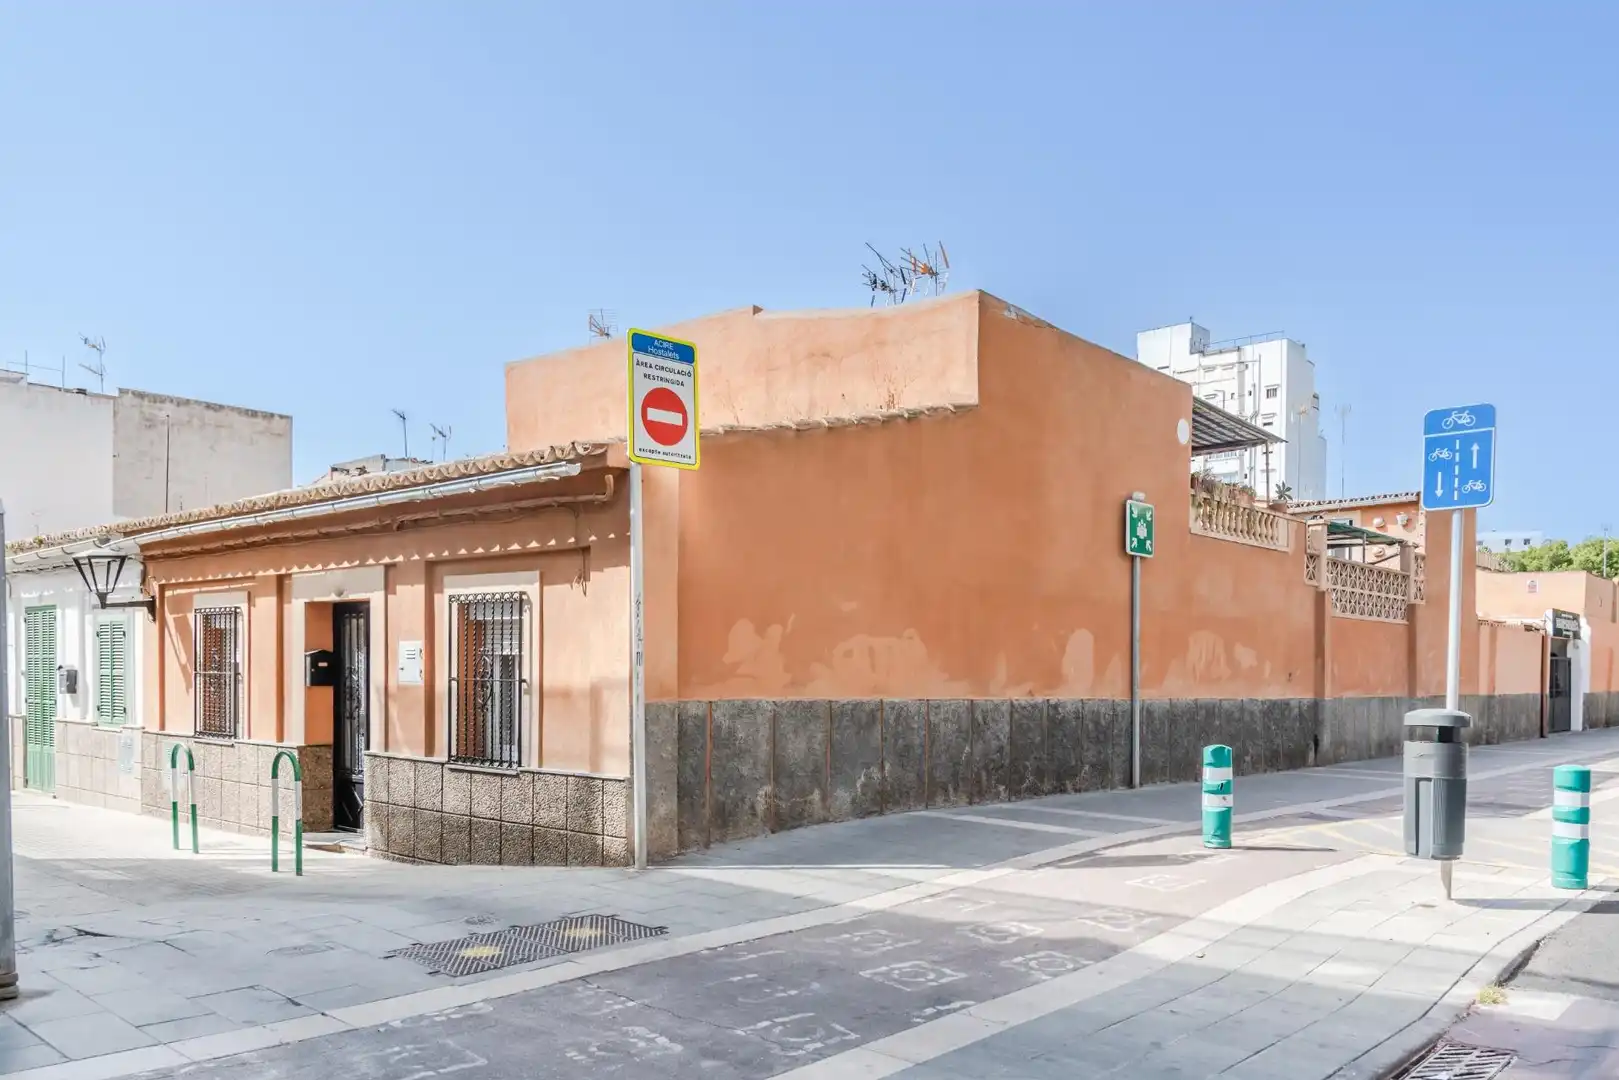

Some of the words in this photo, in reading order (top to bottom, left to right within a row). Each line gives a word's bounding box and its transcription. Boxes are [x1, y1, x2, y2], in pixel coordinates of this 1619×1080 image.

[647, 345, 680, 360] Hostalets
[654, 364, 692, 378] CIRCULACIÓ
[643, 372, 685, 387] RESTRINGIDA
